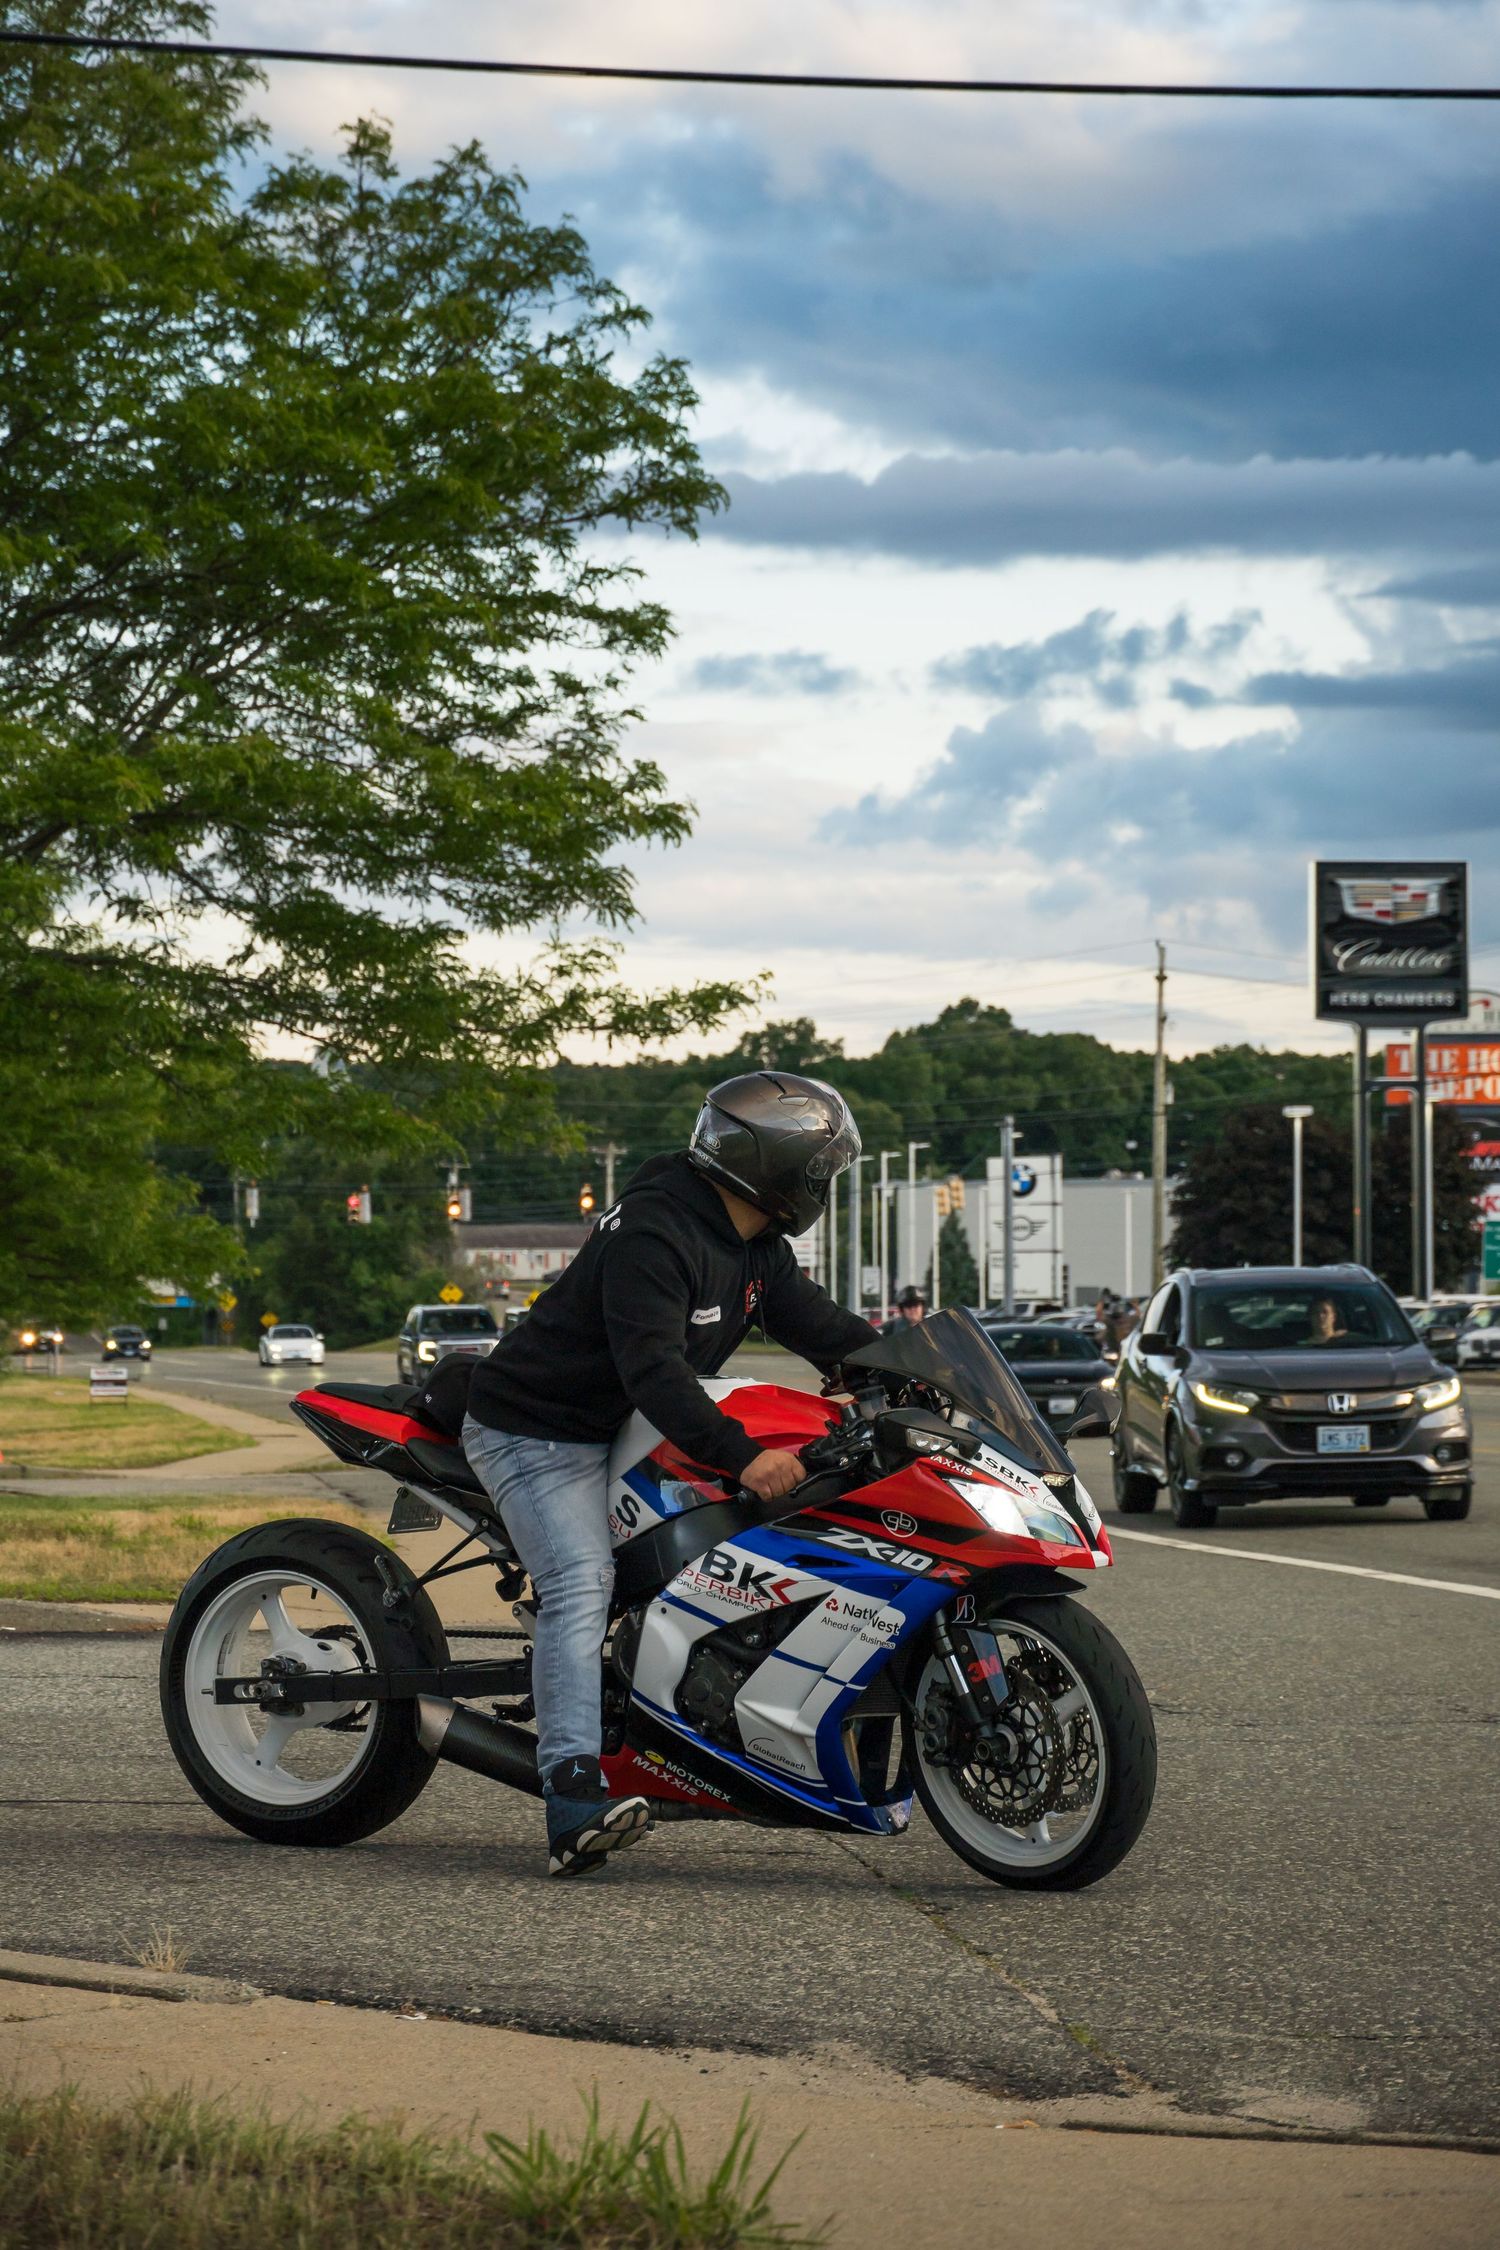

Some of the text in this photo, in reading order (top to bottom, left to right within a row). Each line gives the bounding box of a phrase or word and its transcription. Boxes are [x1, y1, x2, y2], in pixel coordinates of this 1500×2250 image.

[1332, 937, 1452, 974] Cadillac
[984, 1457, 1031, 1490] SBK
[674, 1577, 701, 1593] ORLD
[820, 1616, 895, 1649] Ahead for Business
[843, 1602, 900, 1635] NatWest
[968, 1654, 1001, 1683] 3M
[753, 1743, 806, 1772] GlobalReach
[632, 1755, 699, 1796] MAXXIS
[665, 1761, 732, 1803] MOTOREX
